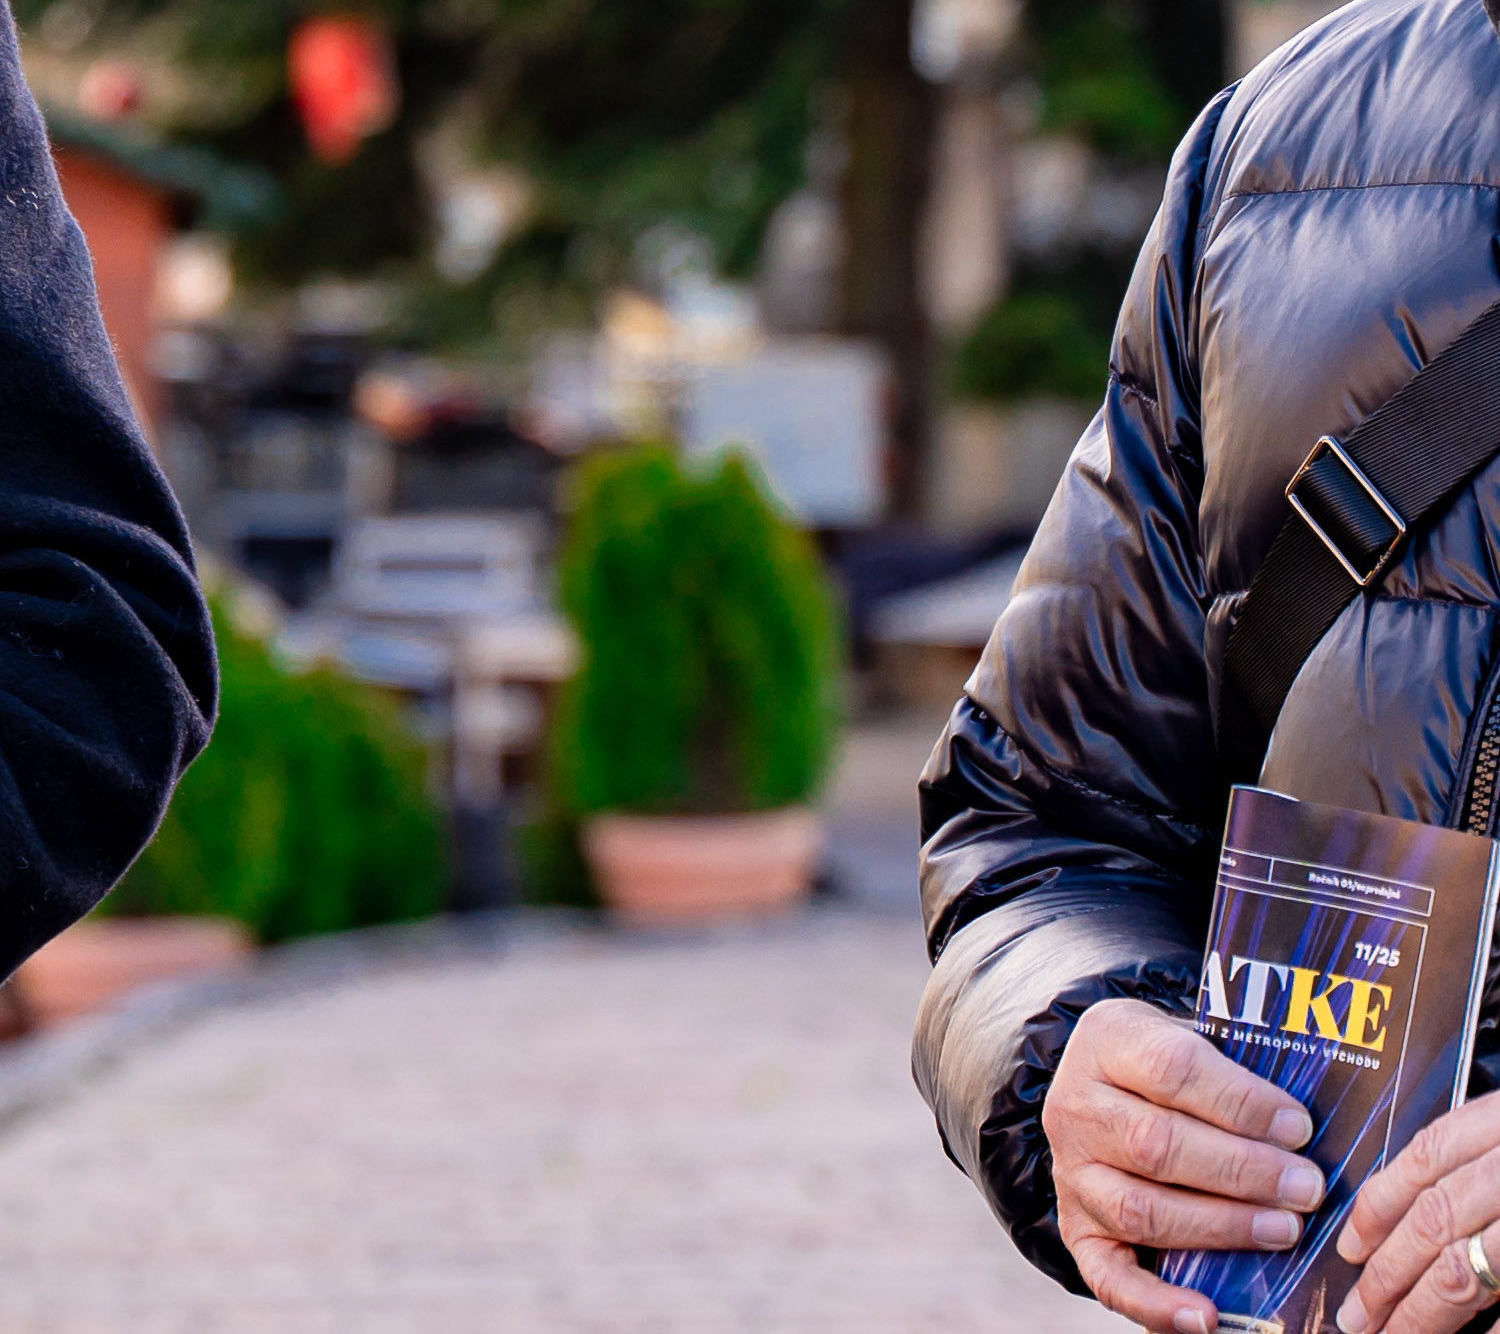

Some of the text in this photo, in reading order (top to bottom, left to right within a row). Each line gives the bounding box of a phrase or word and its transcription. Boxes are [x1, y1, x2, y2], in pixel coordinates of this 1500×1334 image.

[1354, 941, 1401, 968] 11/25
[1220, 1028, 1230, 1040] Z
[1233, 1030, 1316, 1054] METROPOLY
